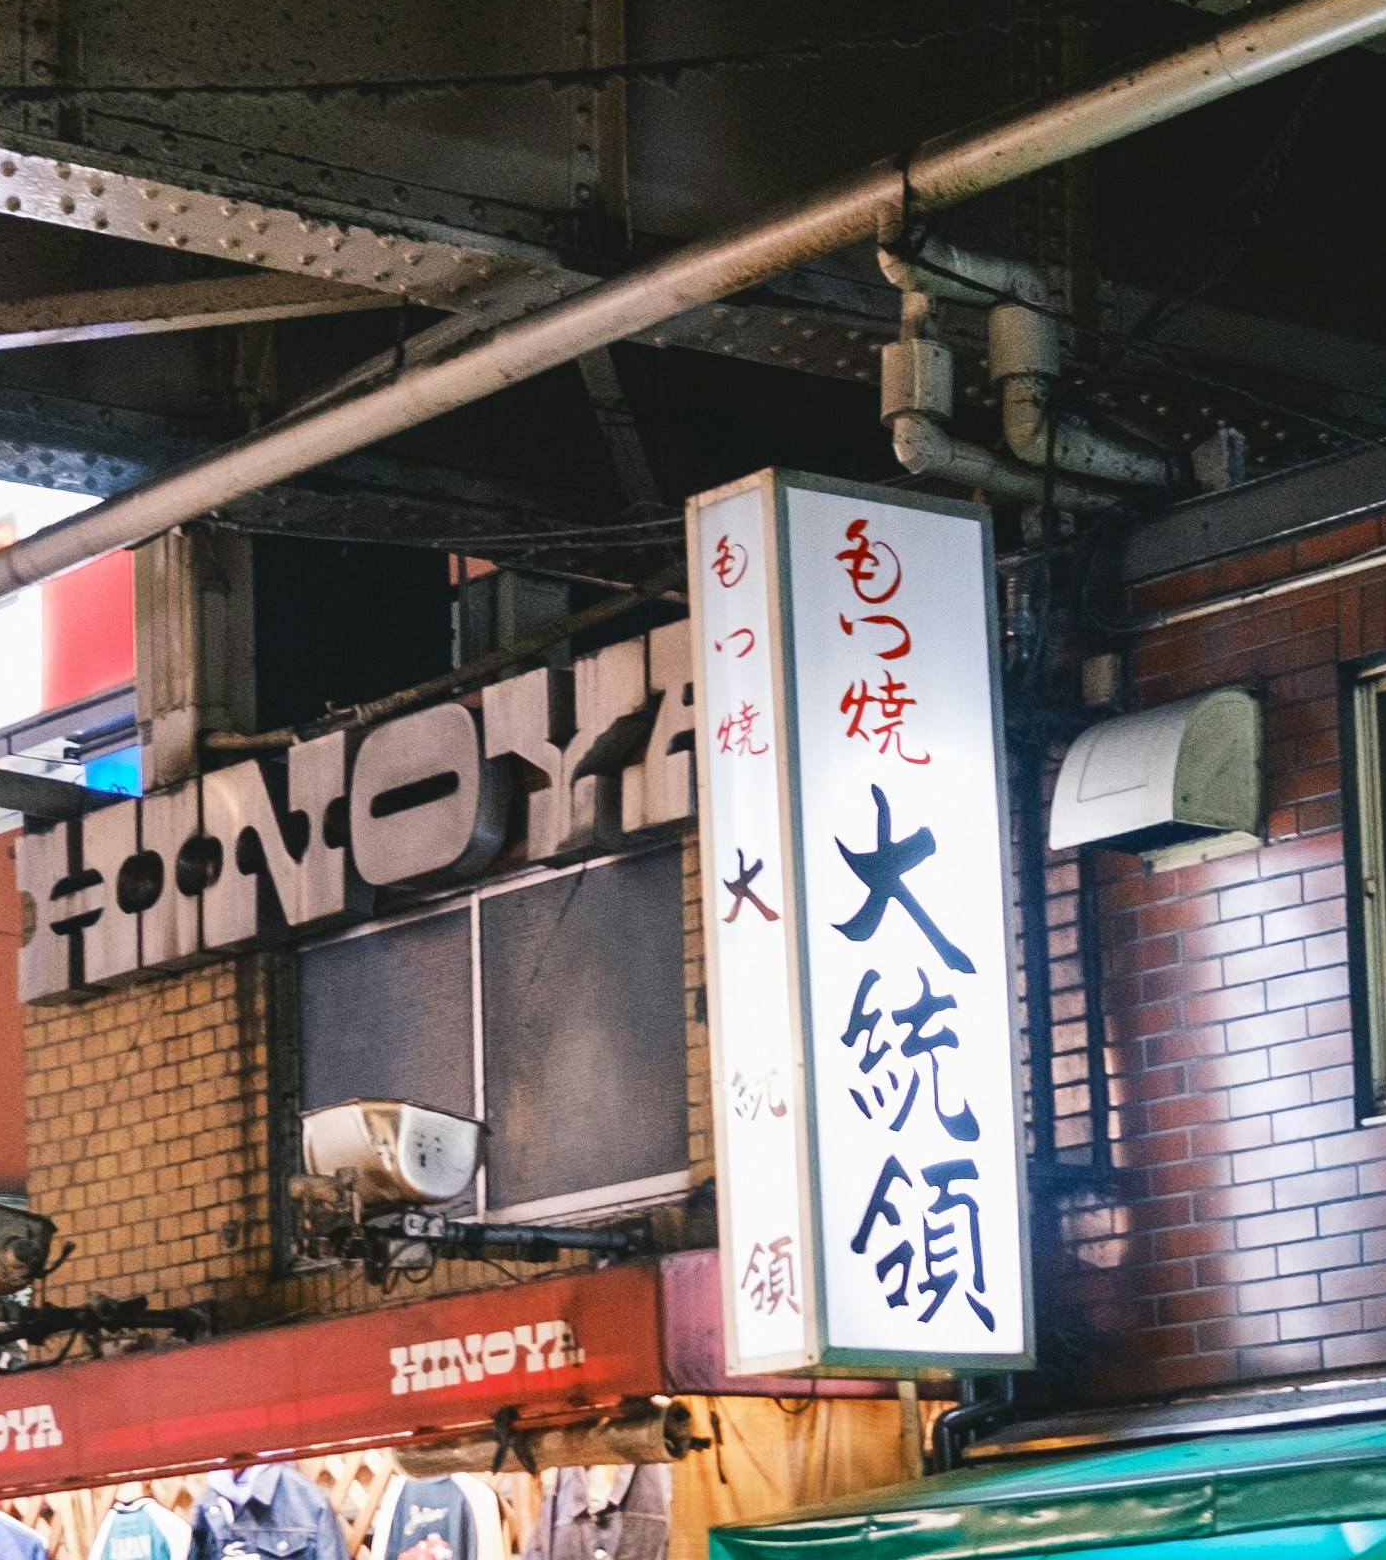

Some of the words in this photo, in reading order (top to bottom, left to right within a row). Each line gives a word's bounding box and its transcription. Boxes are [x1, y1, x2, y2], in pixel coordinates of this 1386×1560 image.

[835, 517, 931, 766] もつ焼
[829, 783, 996, 1335] 大統領
[389, 1320, 586, 1395] HINOYA
